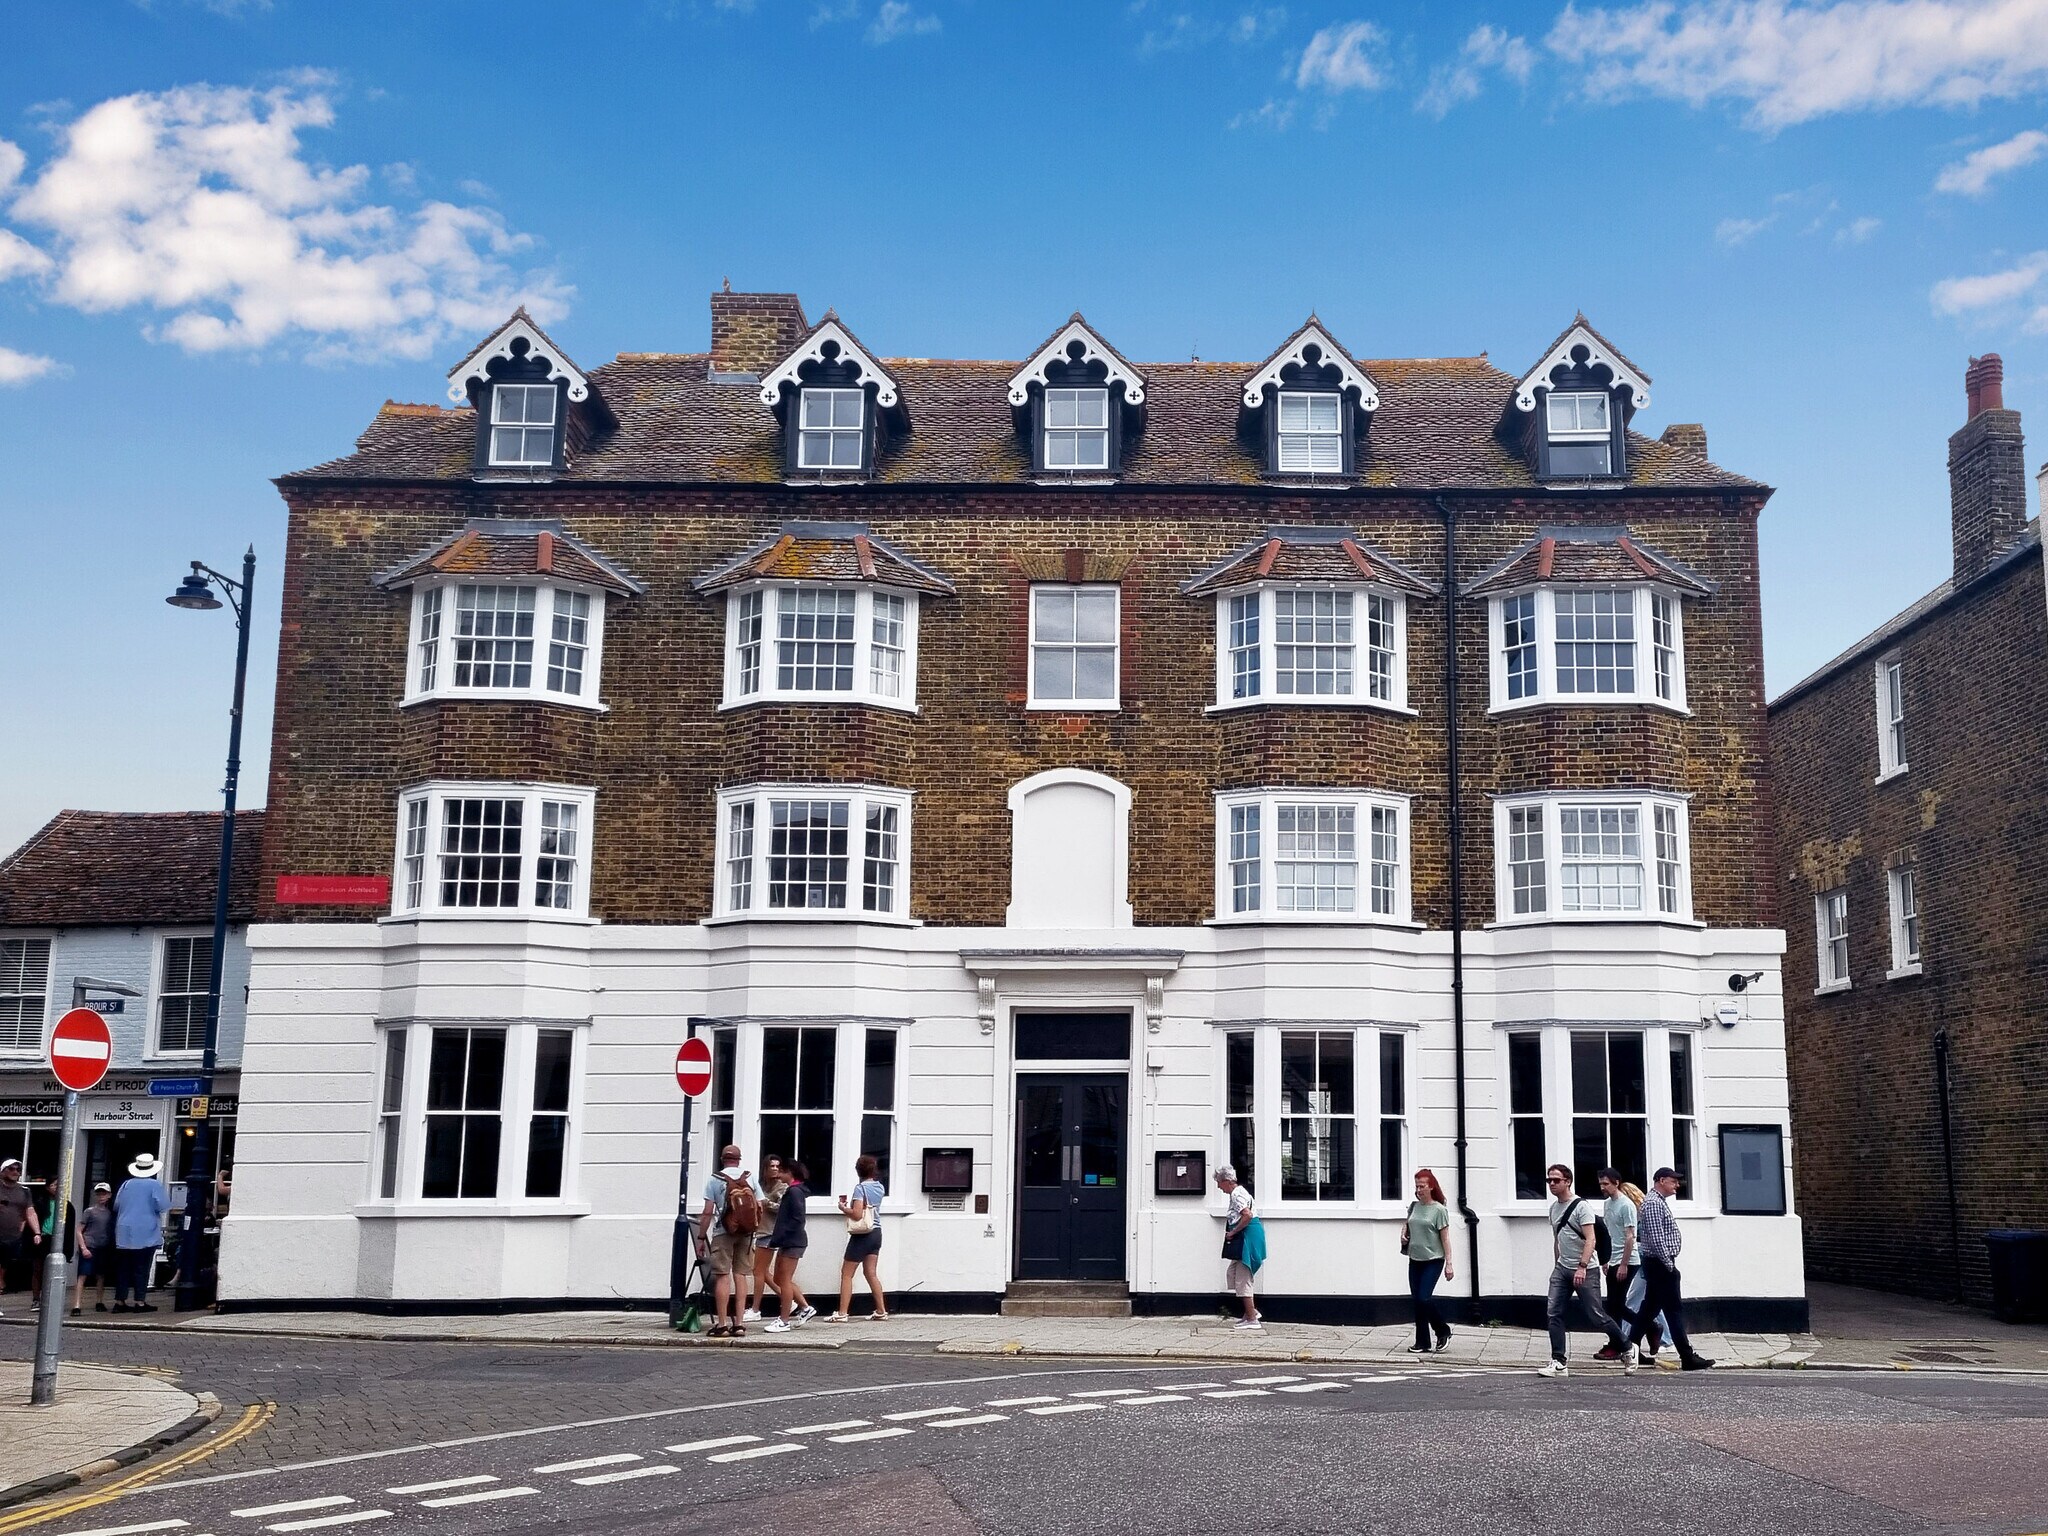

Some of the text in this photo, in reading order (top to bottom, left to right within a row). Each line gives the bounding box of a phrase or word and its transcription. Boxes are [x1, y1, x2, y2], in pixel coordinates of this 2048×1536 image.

[348, 886, 378, 894] Architects
[85, 1002, 107, 1011] RBOUR
[43, 1080, 147, 1091] WHIBLE PROD
[0, 1101, 31, 1113] oothies
[119, 1101, 133, 1111] 33
[94, 1111, 154, 1120] Harbour Street
